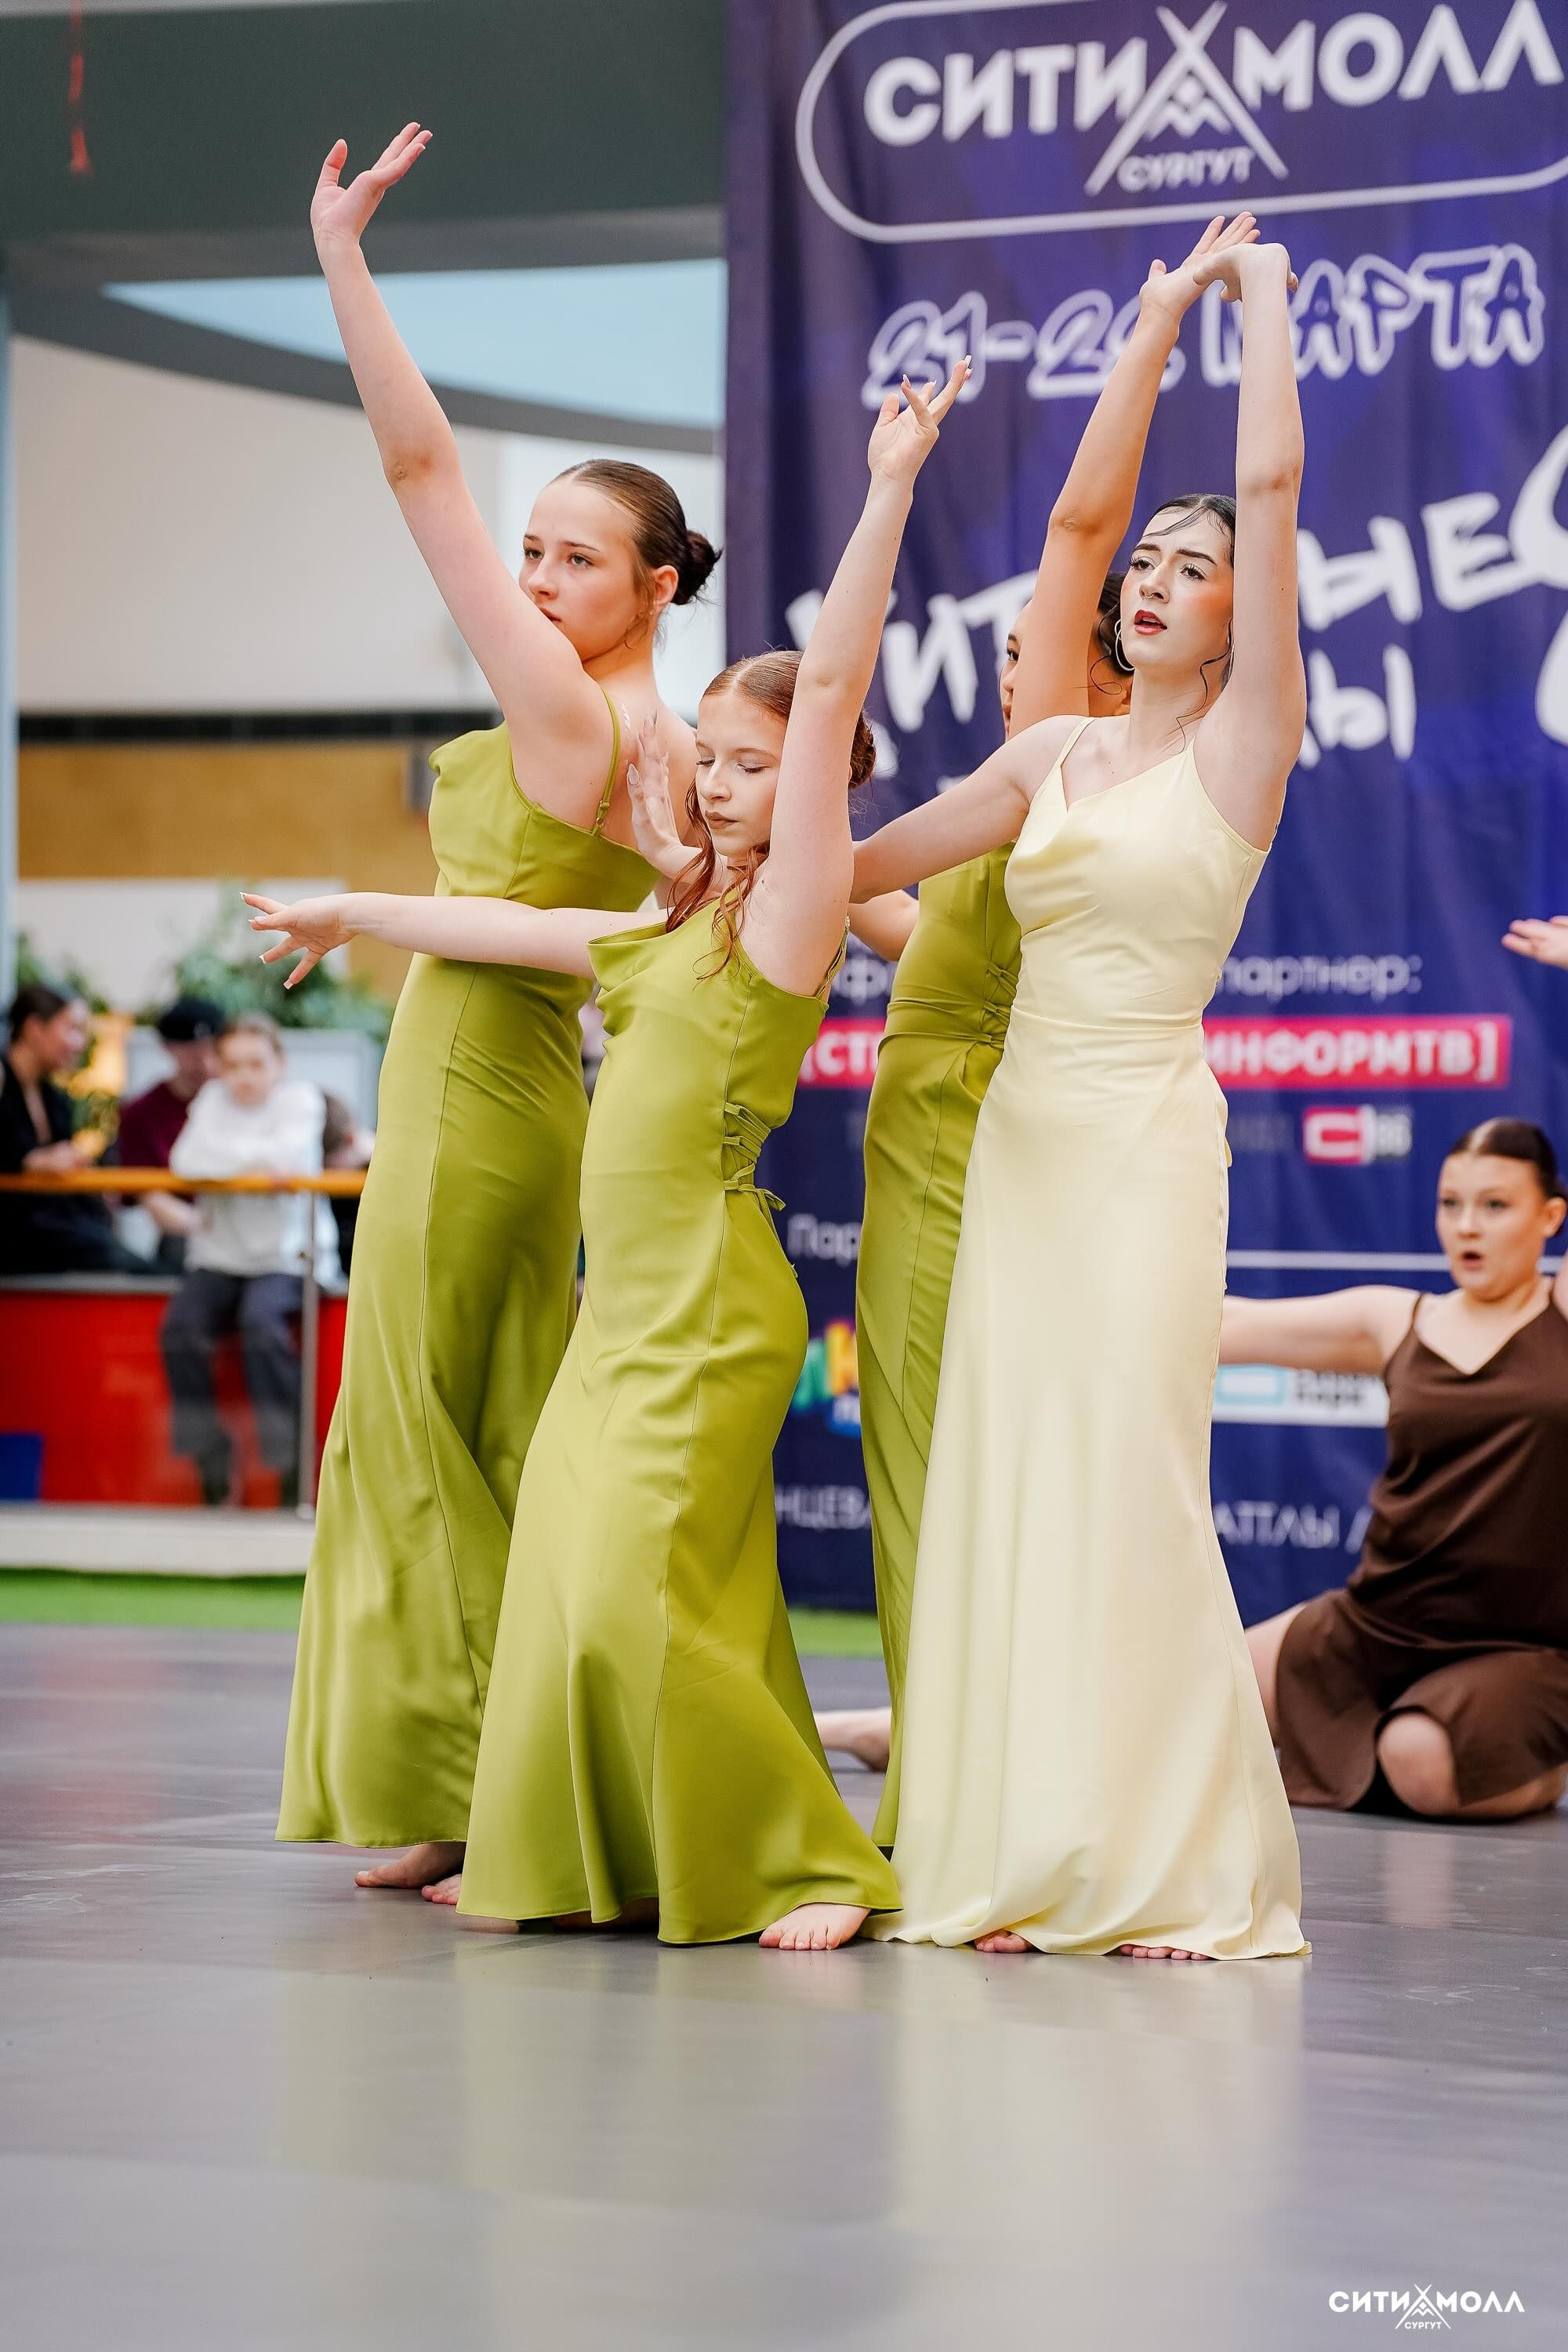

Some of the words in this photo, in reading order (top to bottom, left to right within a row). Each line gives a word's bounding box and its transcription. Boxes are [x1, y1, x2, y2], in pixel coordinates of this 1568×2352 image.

[864, 36, 1148, 147] СИТИ
[1233, 0, 1564, 112] МОЛЛ
[1117, 147, 1254, 193] СУРГУТ
